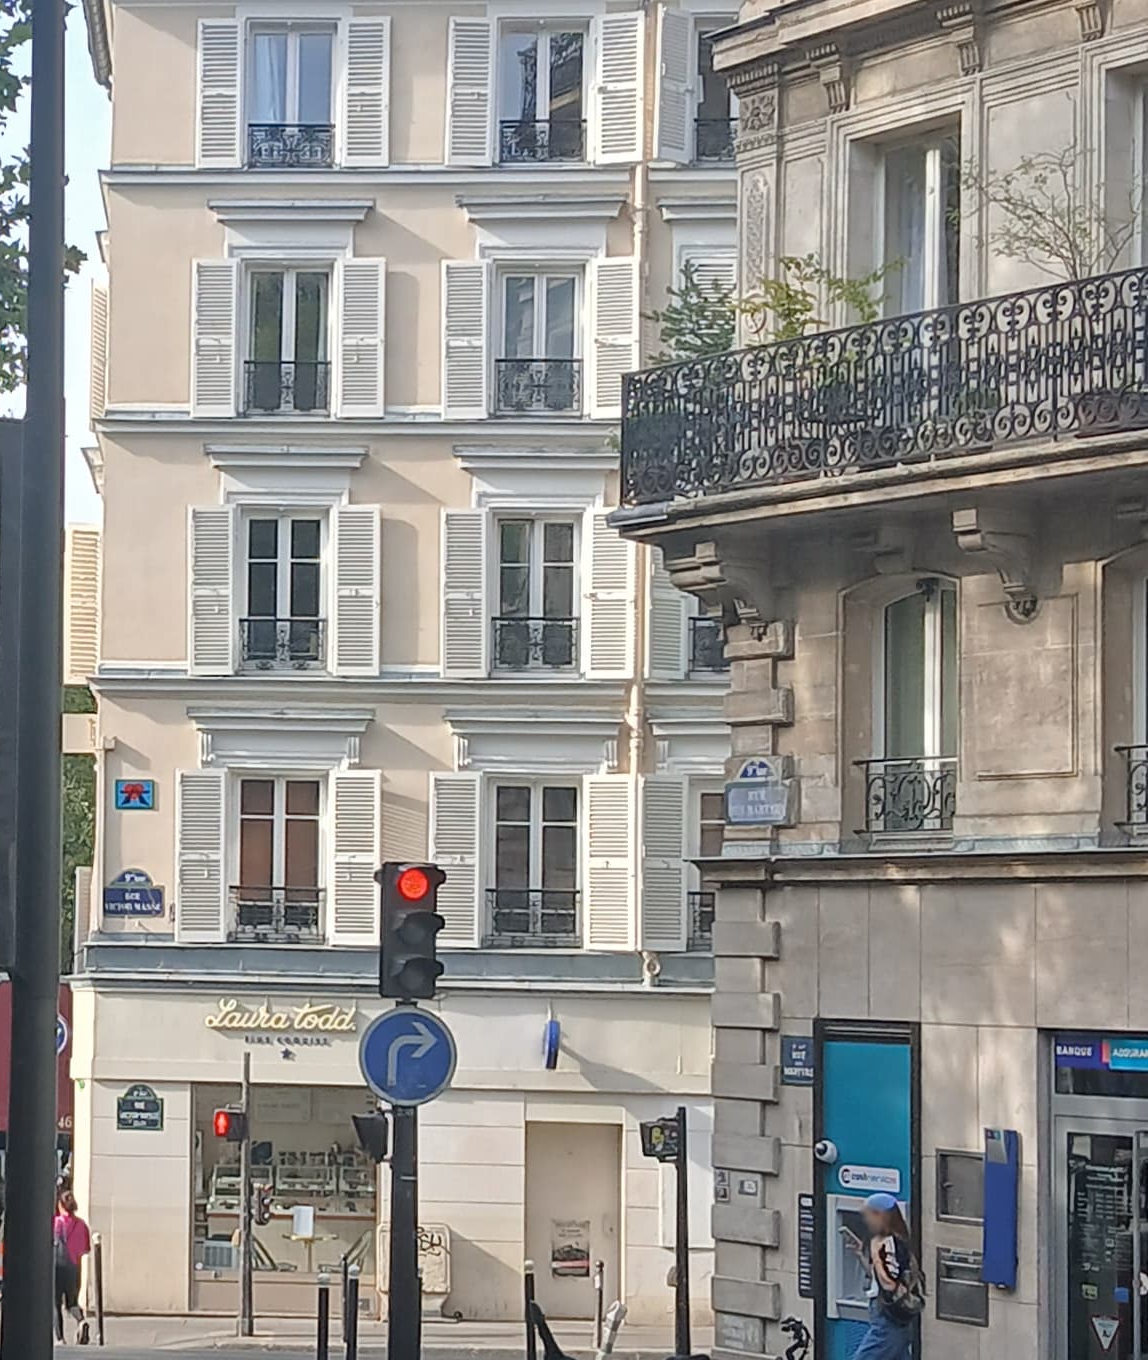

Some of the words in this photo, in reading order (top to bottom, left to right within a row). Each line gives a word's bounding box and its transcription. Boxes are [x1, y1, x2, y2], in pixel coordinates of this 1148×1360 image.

[205, 998, 290, 1029] Laura
[1056, 1045, 1093, 1056] BANQUE
[58, 1115, 73, 1129] 46
